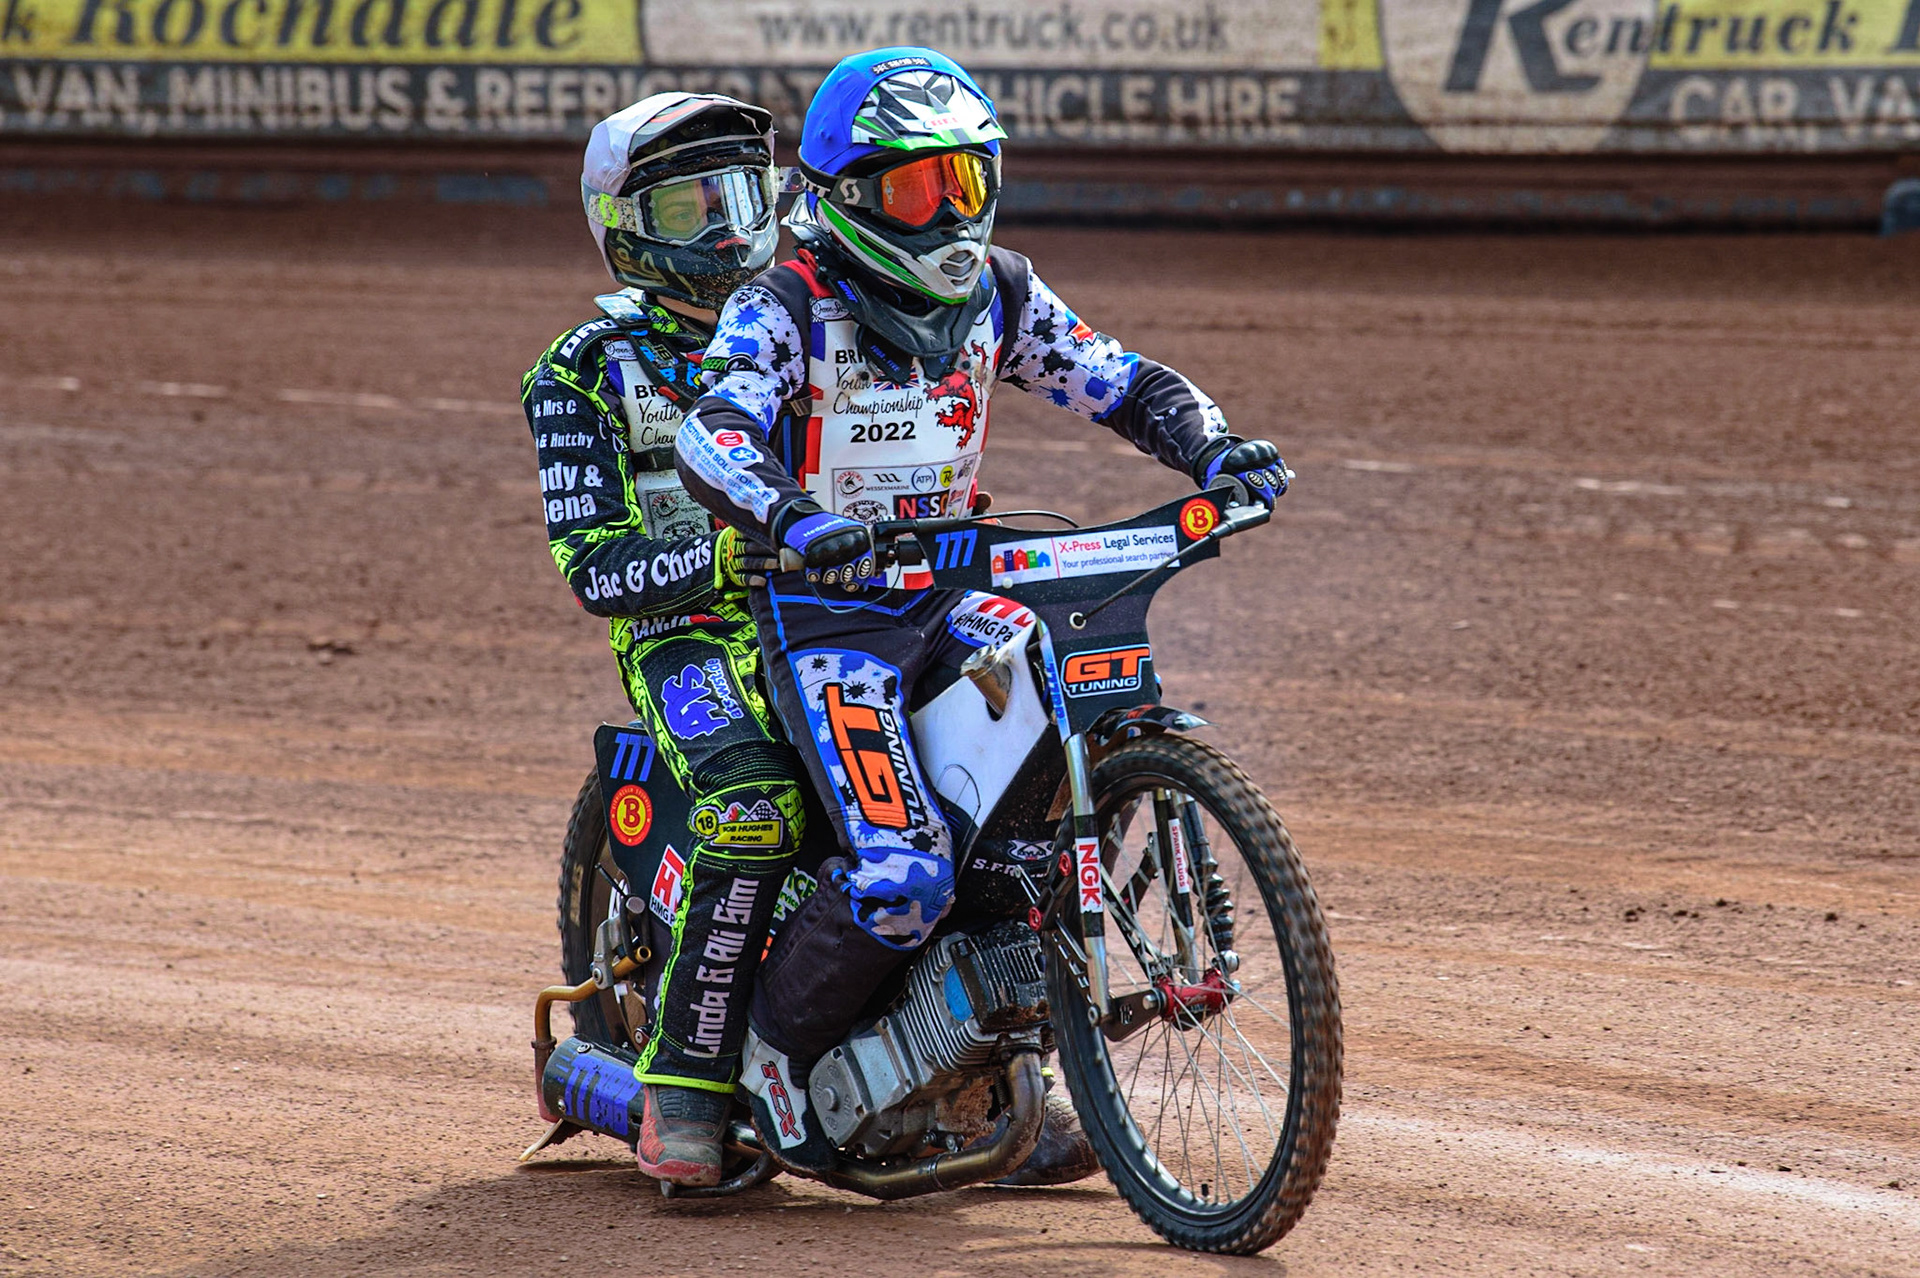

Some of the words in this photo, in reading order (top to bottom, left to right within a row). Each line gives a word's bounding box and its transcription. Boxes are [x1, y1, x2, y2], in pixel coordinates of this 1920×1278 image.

[11, 63, 158, 136] VAN,
[168, 65, 411, 130] MINIBUS
[425, 66, 466, 132] &
[982, 72, 1157, 138] HICLE
[1167, 72, 1300, 138] HIRE
[1828, 75, 1920, 140] VA
[543, 399, 564, 416] Mrs
[638, 400, 681, 424] Youth
[832, 389, 923, 422] Championship
[539, 433, 548, 448] &
[550, 431, 594, 449] Hutchy
[850, 421, 916, 443] 2022
[584, 463, 604, 488] &
[915, 473, 933, 485] ATPI
[544, 493, 597, 523] ena
[934, 529, 978, 570] 777
[1058, 540, 1102, 553] X-Press
[1103, 537, 1131, 551] Legal
[1132, 532, 1175, 547] Services
[585, 566, 623, 601] Jac
[625, 560, 647, 593] &
[650, 538, 712, 587] Chris
[1062, 559, 1080, 569] Your
[1081, 554, 1122, 569] professional
[1123, 551, 1148, 563] search
[1065, 648, 1150, 684] GT
[1068, 677, 1138, 694] TUNING
[609, 732, 656, 783] 777
[826, 685, 909, 829] GT
[878, 710, 927, 827] TUNING
[622, 798, 640, 828] B
[697, 815, 714, 831] 18
[738, 823, 773, 832] HUGHES
[729, 835, 763, 843] RACING
[1171, 825, 1181, 856] SPARK
[1176, 857, 1186, 887] PLUGS
[1078, 843, 1102, 907] NGK
[712, 877, 760, 925] Sim
[696, 965, 735, 984] &
[683, 990, 731, 1058] Linda
